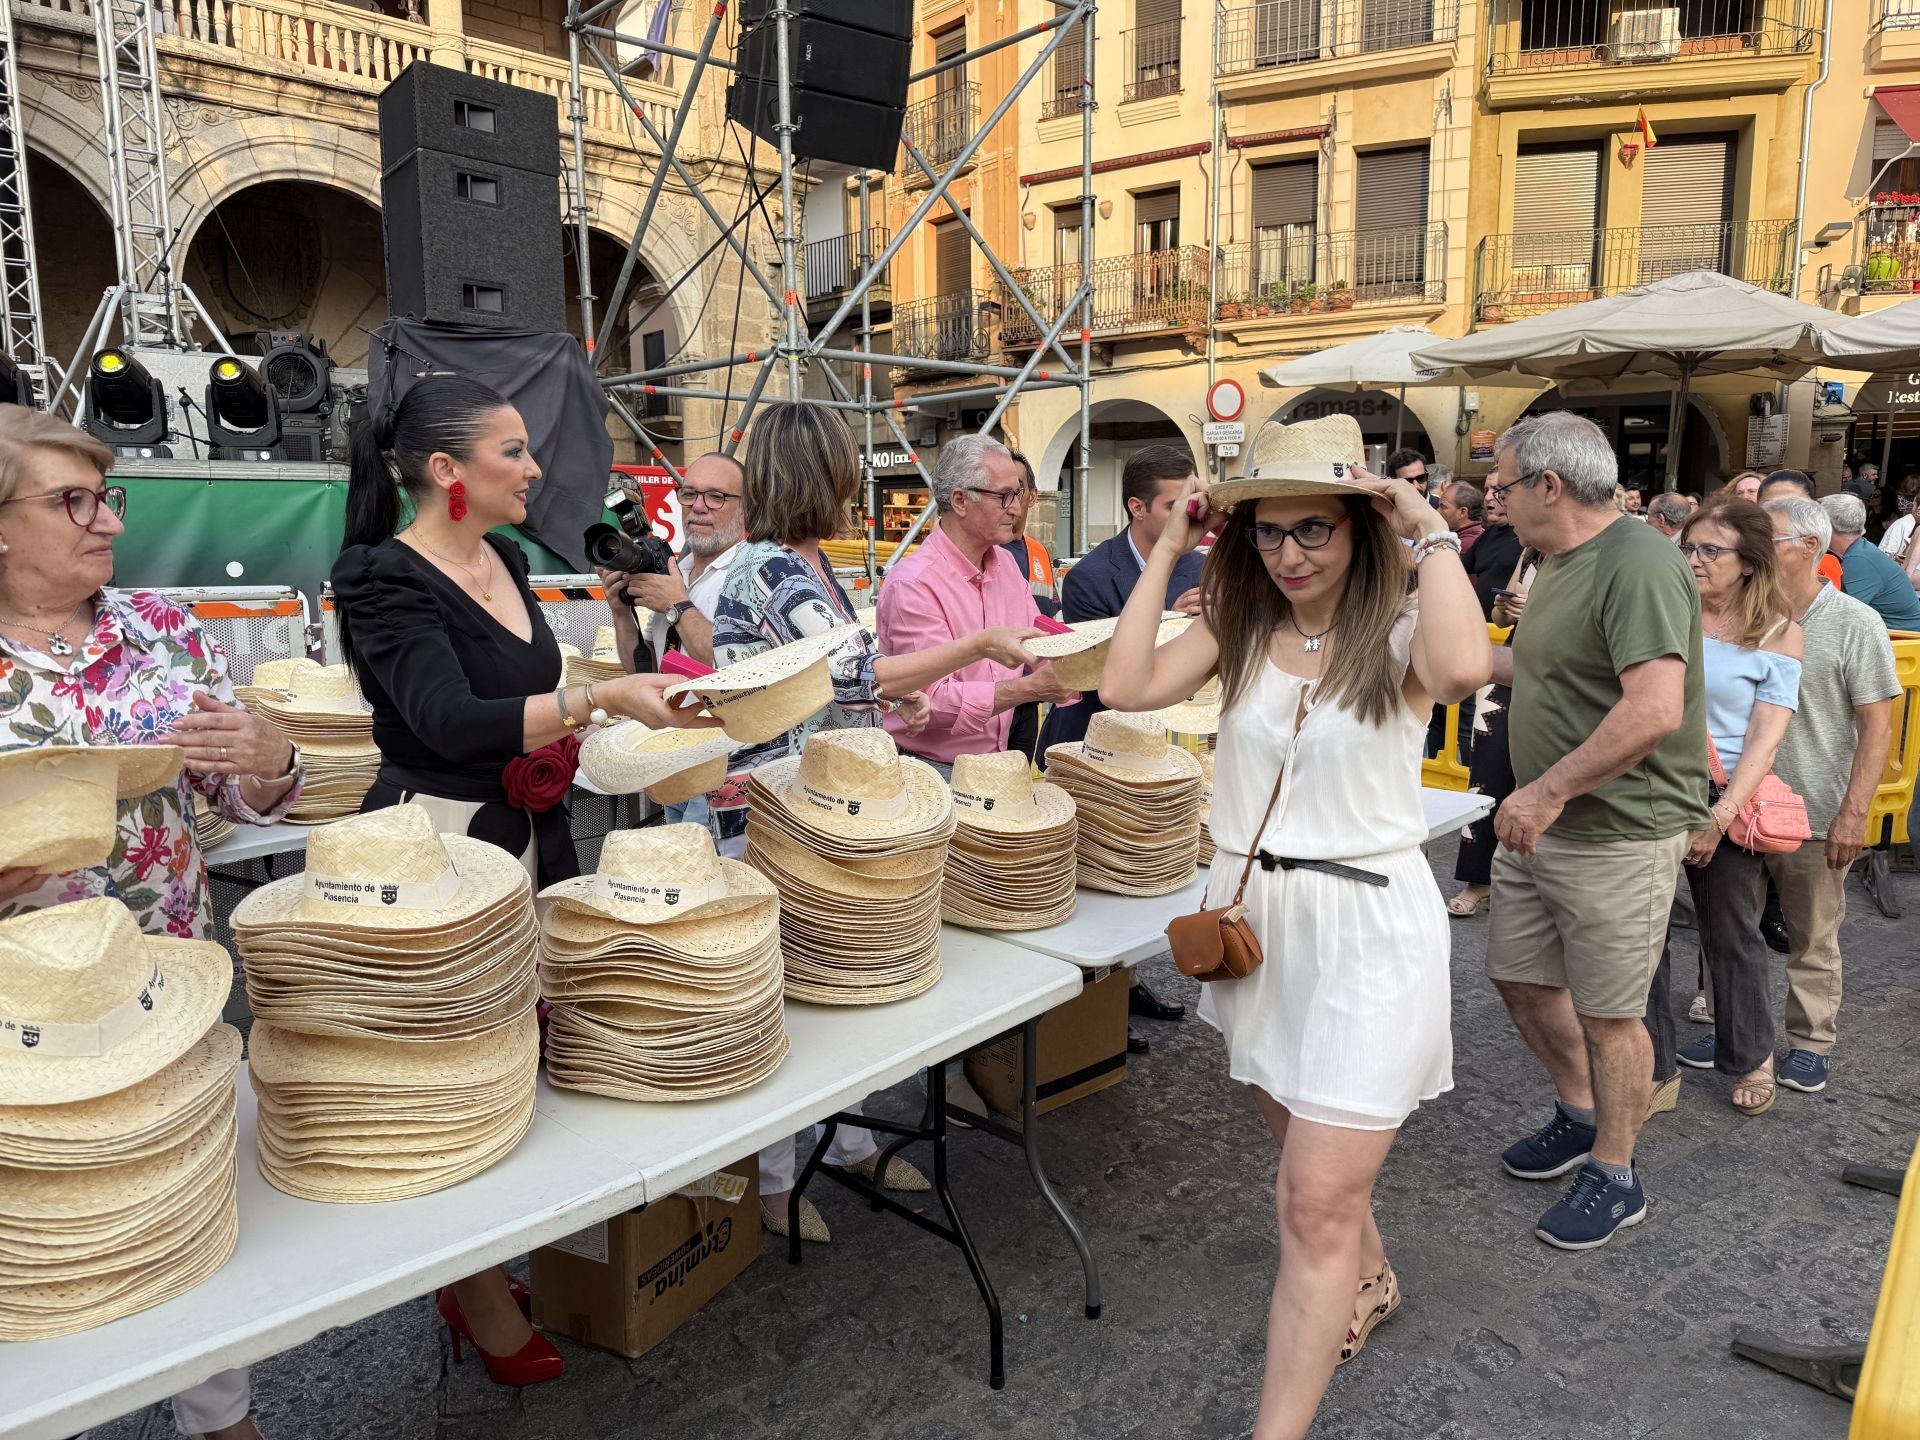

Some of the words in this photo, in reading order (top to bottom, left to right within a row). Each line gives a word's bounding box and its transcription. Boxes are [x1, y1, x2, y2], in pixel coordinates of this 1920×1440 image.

[662, 476, 673, 484] DE
[803, 784, 836, 803] Ayuntamiento
[836, 797, 845, 805] de
[807, 796, 833, 811] Plasencia
[314, 878, 362, 892] Ayuntamiento
[364, 883, 376, 893] de
[607, 879, 649, 894] Ayuntamiento
[650, 886, 661, 895] de
[323, 891, 359, 904] Plasencia
[613, 891, 646, 904] Plasencia
[5, 1020, 16, 1031] de
[639, 1242, 692, 1285] POWERIDEAS
